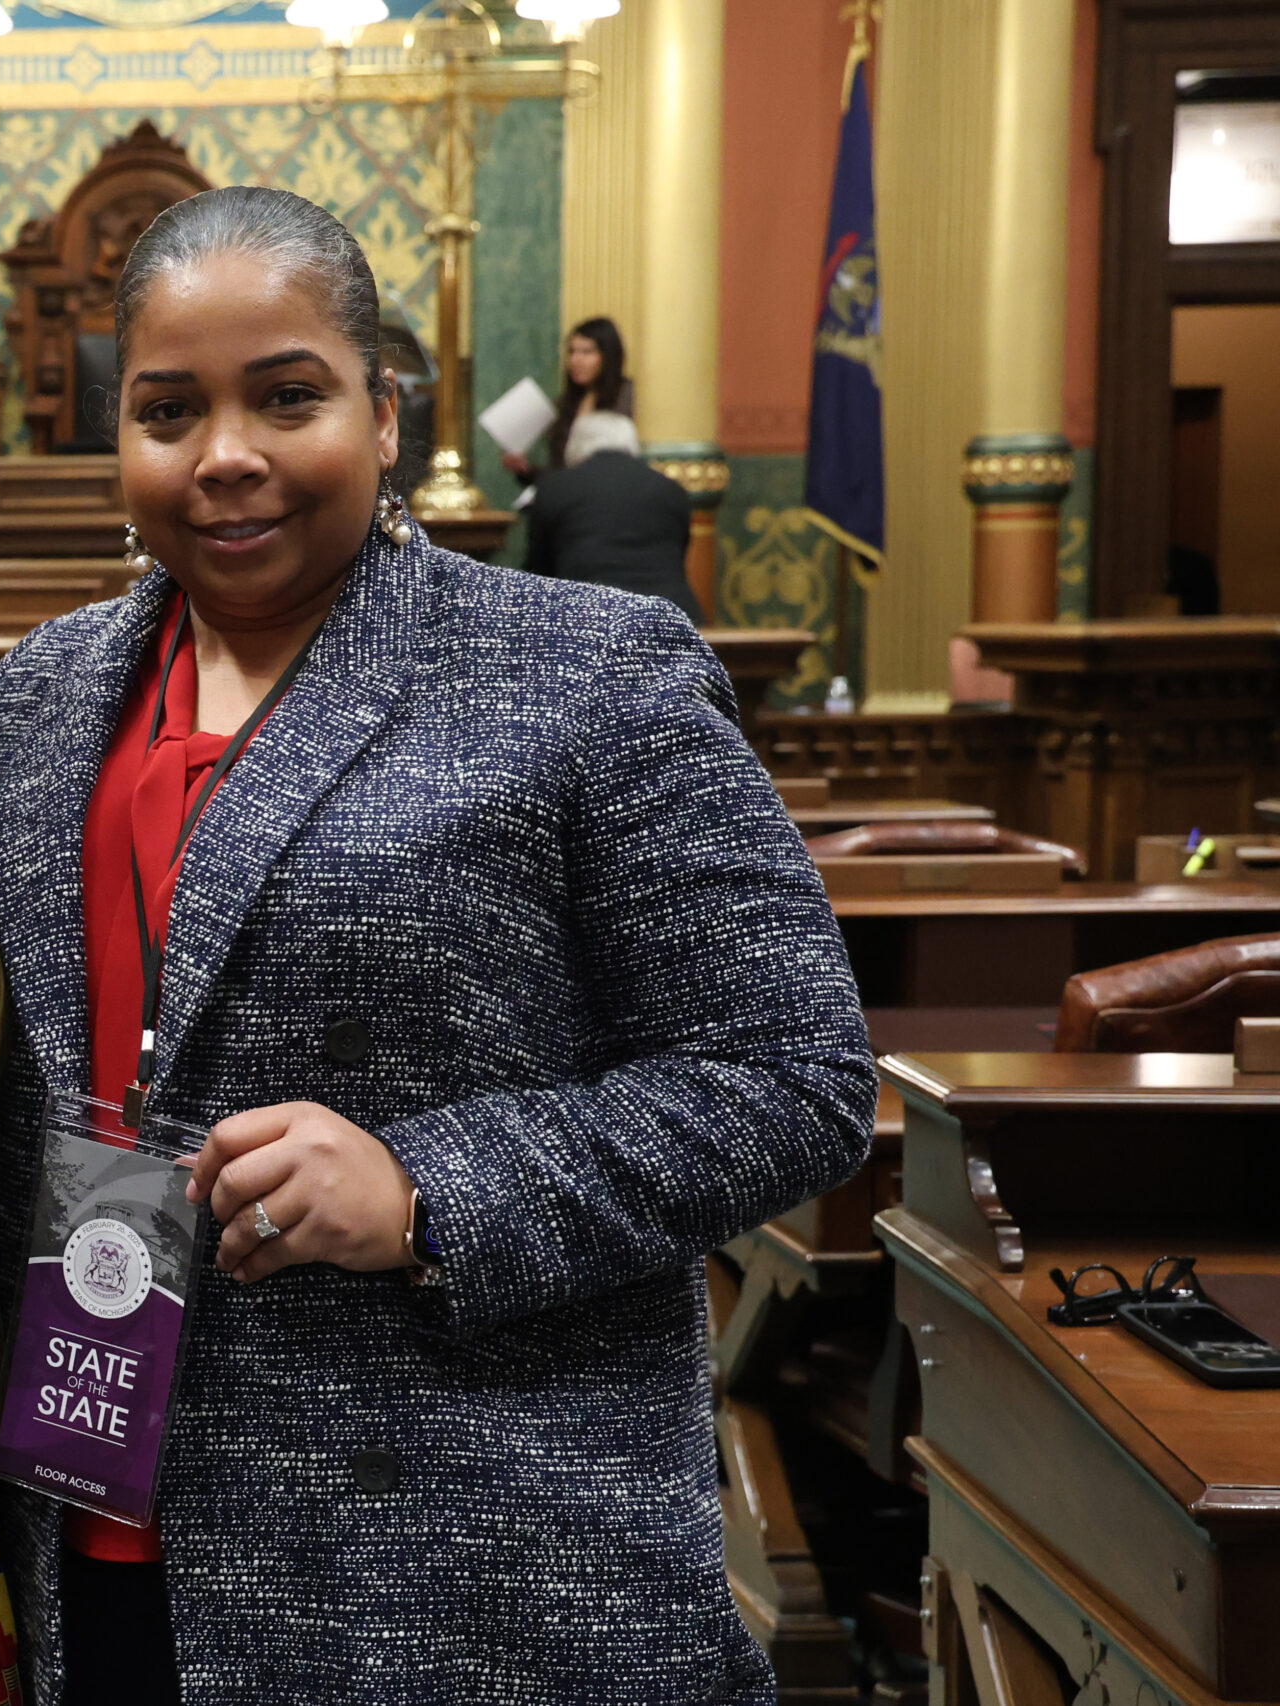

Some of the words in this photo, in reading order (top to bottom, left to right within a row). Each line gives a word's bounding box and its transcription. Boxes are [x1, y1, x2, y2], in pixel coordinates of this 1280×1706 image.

[81, 1222, 115, 1234] FEBRUARY
[127, 1231, 142, 1248] 2025
[73, 1290, 88, 1306] STATE
[88, 1304, 98, 1313] OF
[99, 1304, 133, 1317] MICHIGAN
[46, 1337, 138, 1390] STATE
[67, 1375, 85, 1388] OF
[87, 1380, 109, 1398] THE
[37, 1385, 130, 1438] STATE
[34, 1465, 67, 1483] FLOOR
[68, 1476, 106, 1496] ACCESS
